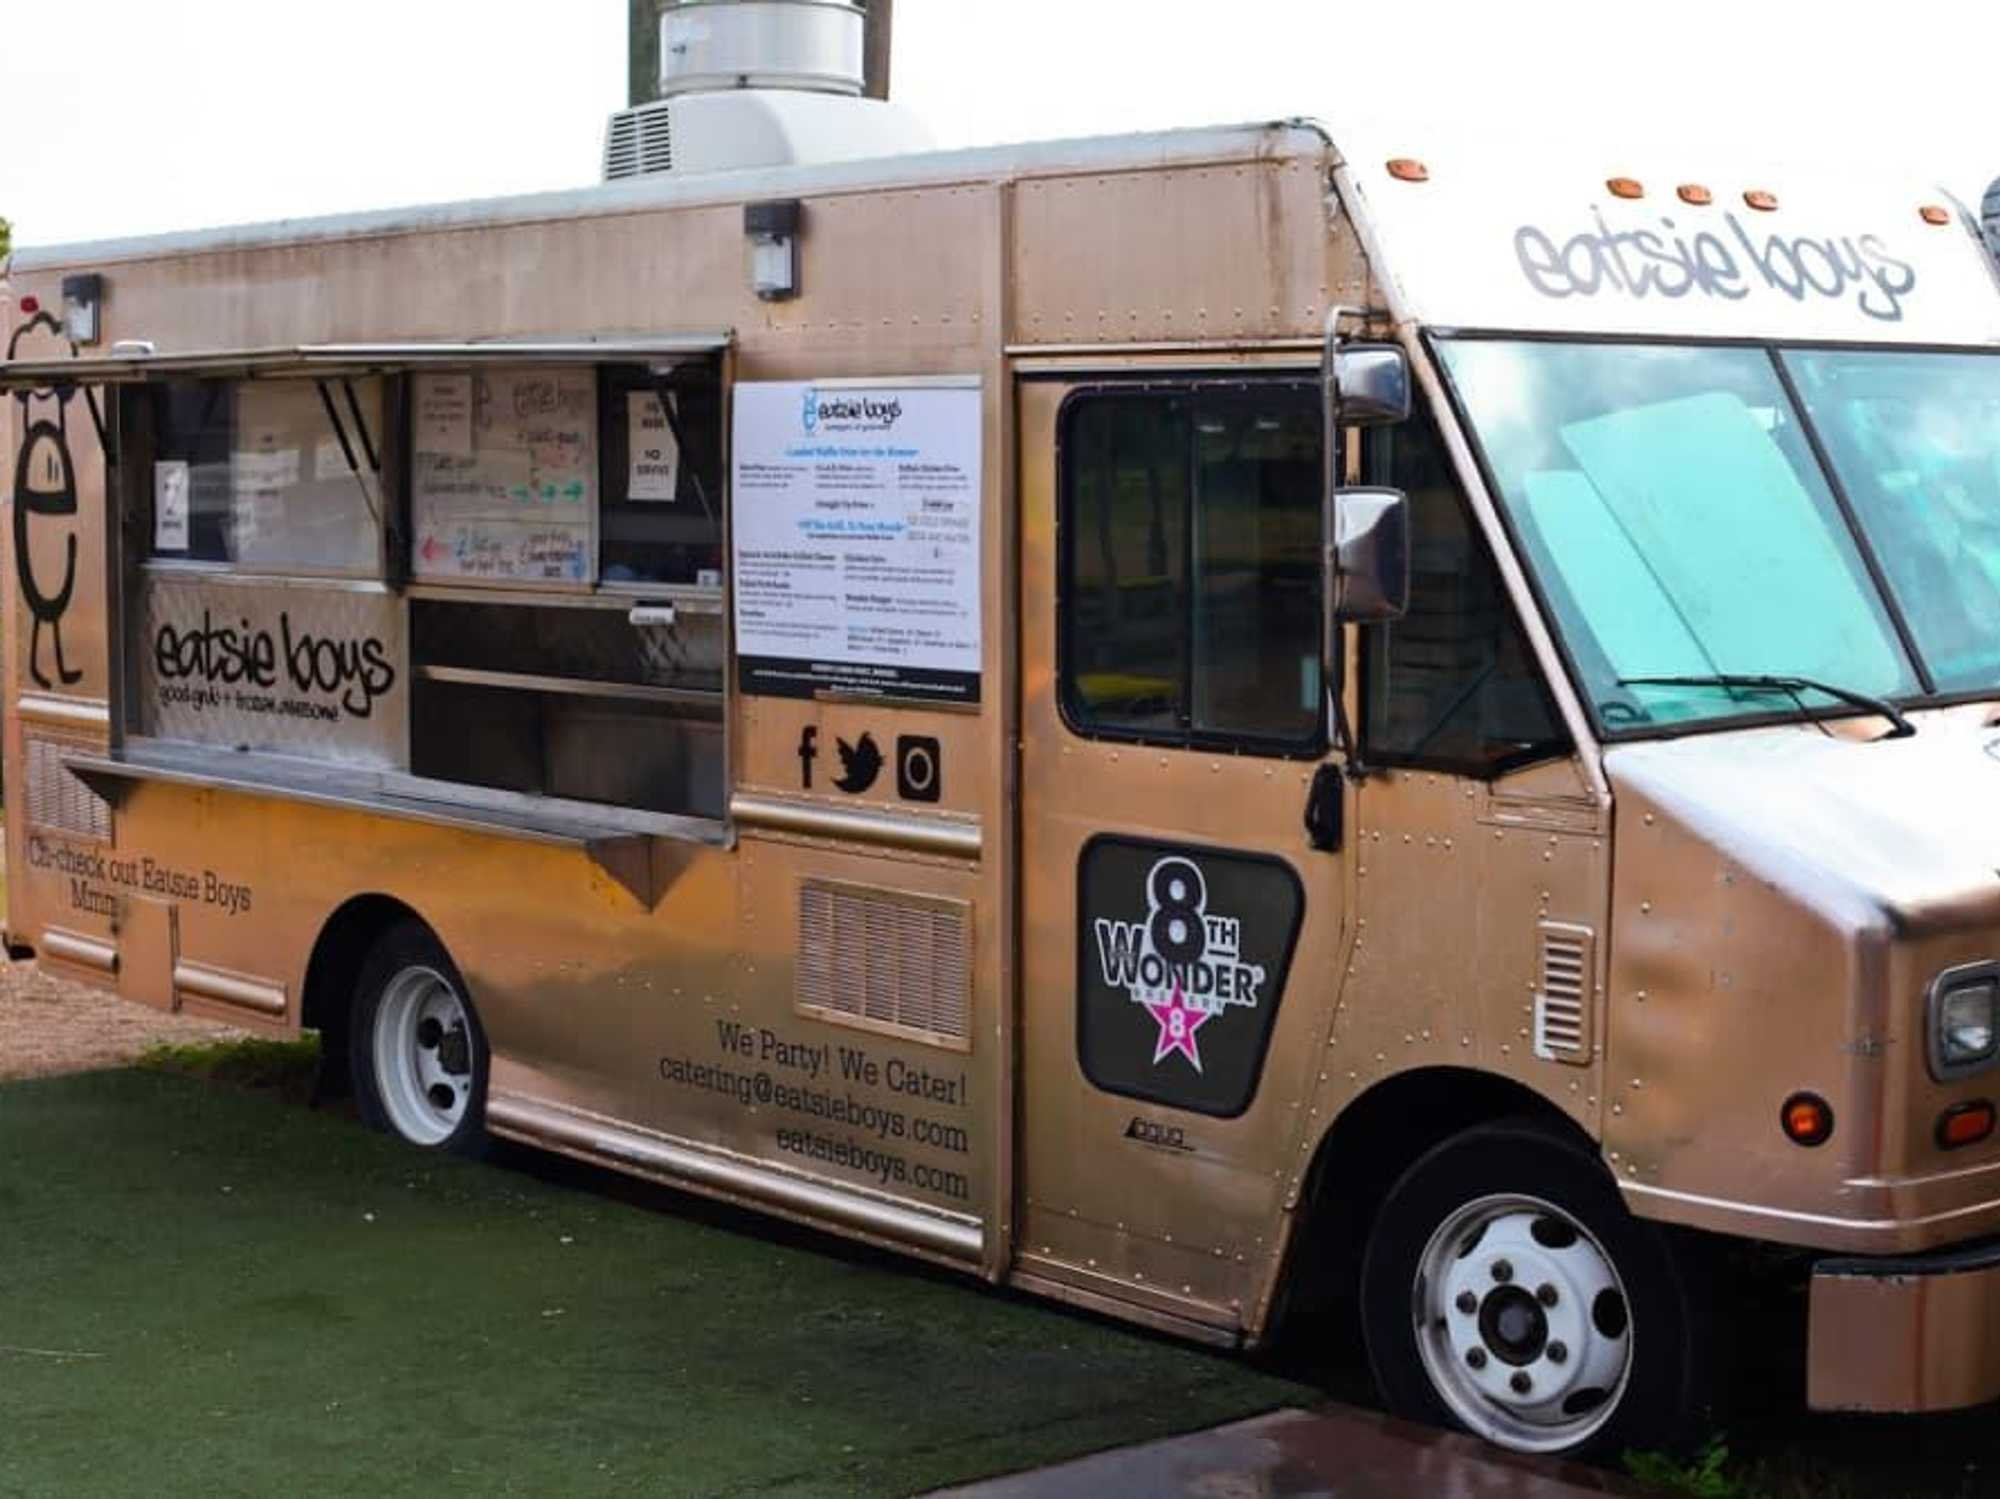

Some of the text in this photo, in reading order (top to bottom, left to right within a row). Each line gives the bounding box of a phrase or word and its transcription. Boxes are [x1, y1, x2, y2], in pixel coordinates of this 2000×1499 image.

[1514, 204, 1916, 322] eatsie boys
[155, 608, 395, 718] eatsie boys
[110, 857, 138, 887] out
[1096, 918, 1257, 1004] WONDER
[659, 1053, 970, 1152] catering@eatsieboys.com
[718, 1019, 967, 1107] We Party! We Cater!
[775, 1126, 969, 1198] eatsieboys.com
